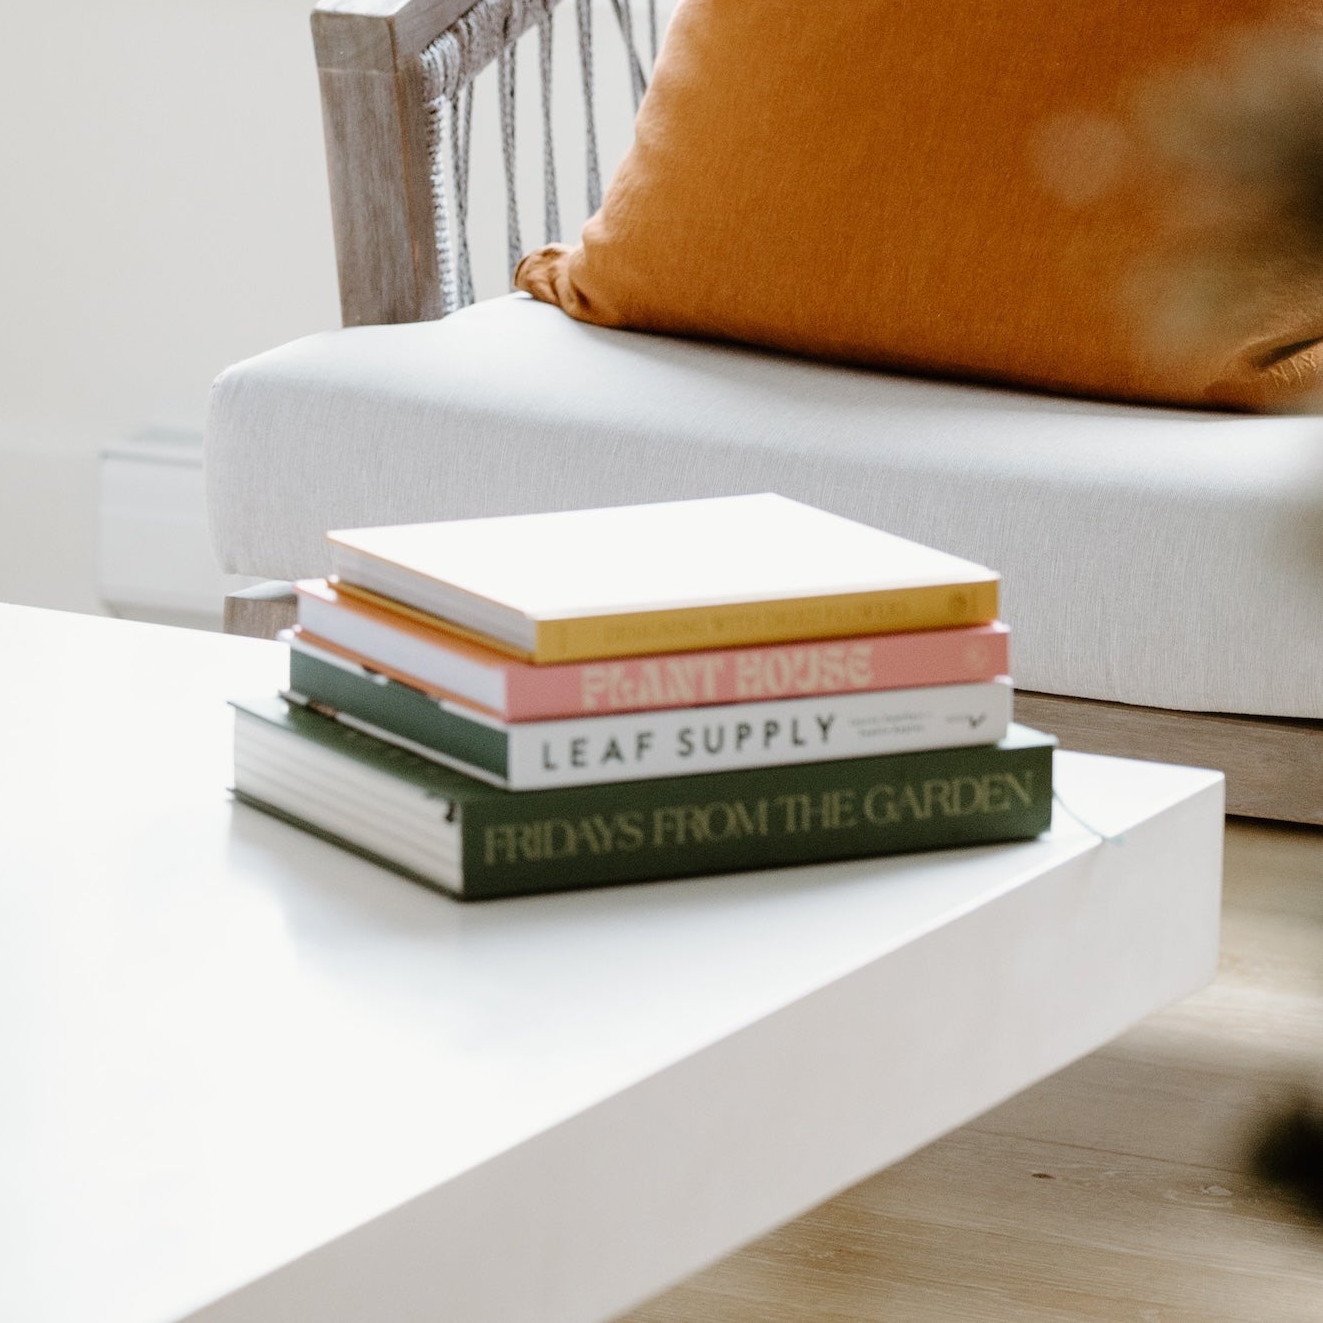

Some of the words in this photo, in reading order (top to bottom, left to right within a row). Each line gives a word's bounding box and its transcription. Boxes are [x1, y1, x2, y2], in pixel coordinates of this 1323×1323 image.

[580, 654, 724, 710] PLANT
[735, 644, 874, 699] HOUSE
[542, 731, 654, 772] LEAF
[676, 712, 836, 758] SUPPLY
[483, 810, 645, 866] FRIDAYS
[653, 797, 769, 846] FROM
[774, 788, 858, 835] THE
[862, 770, 1035, 825] GARDEN
